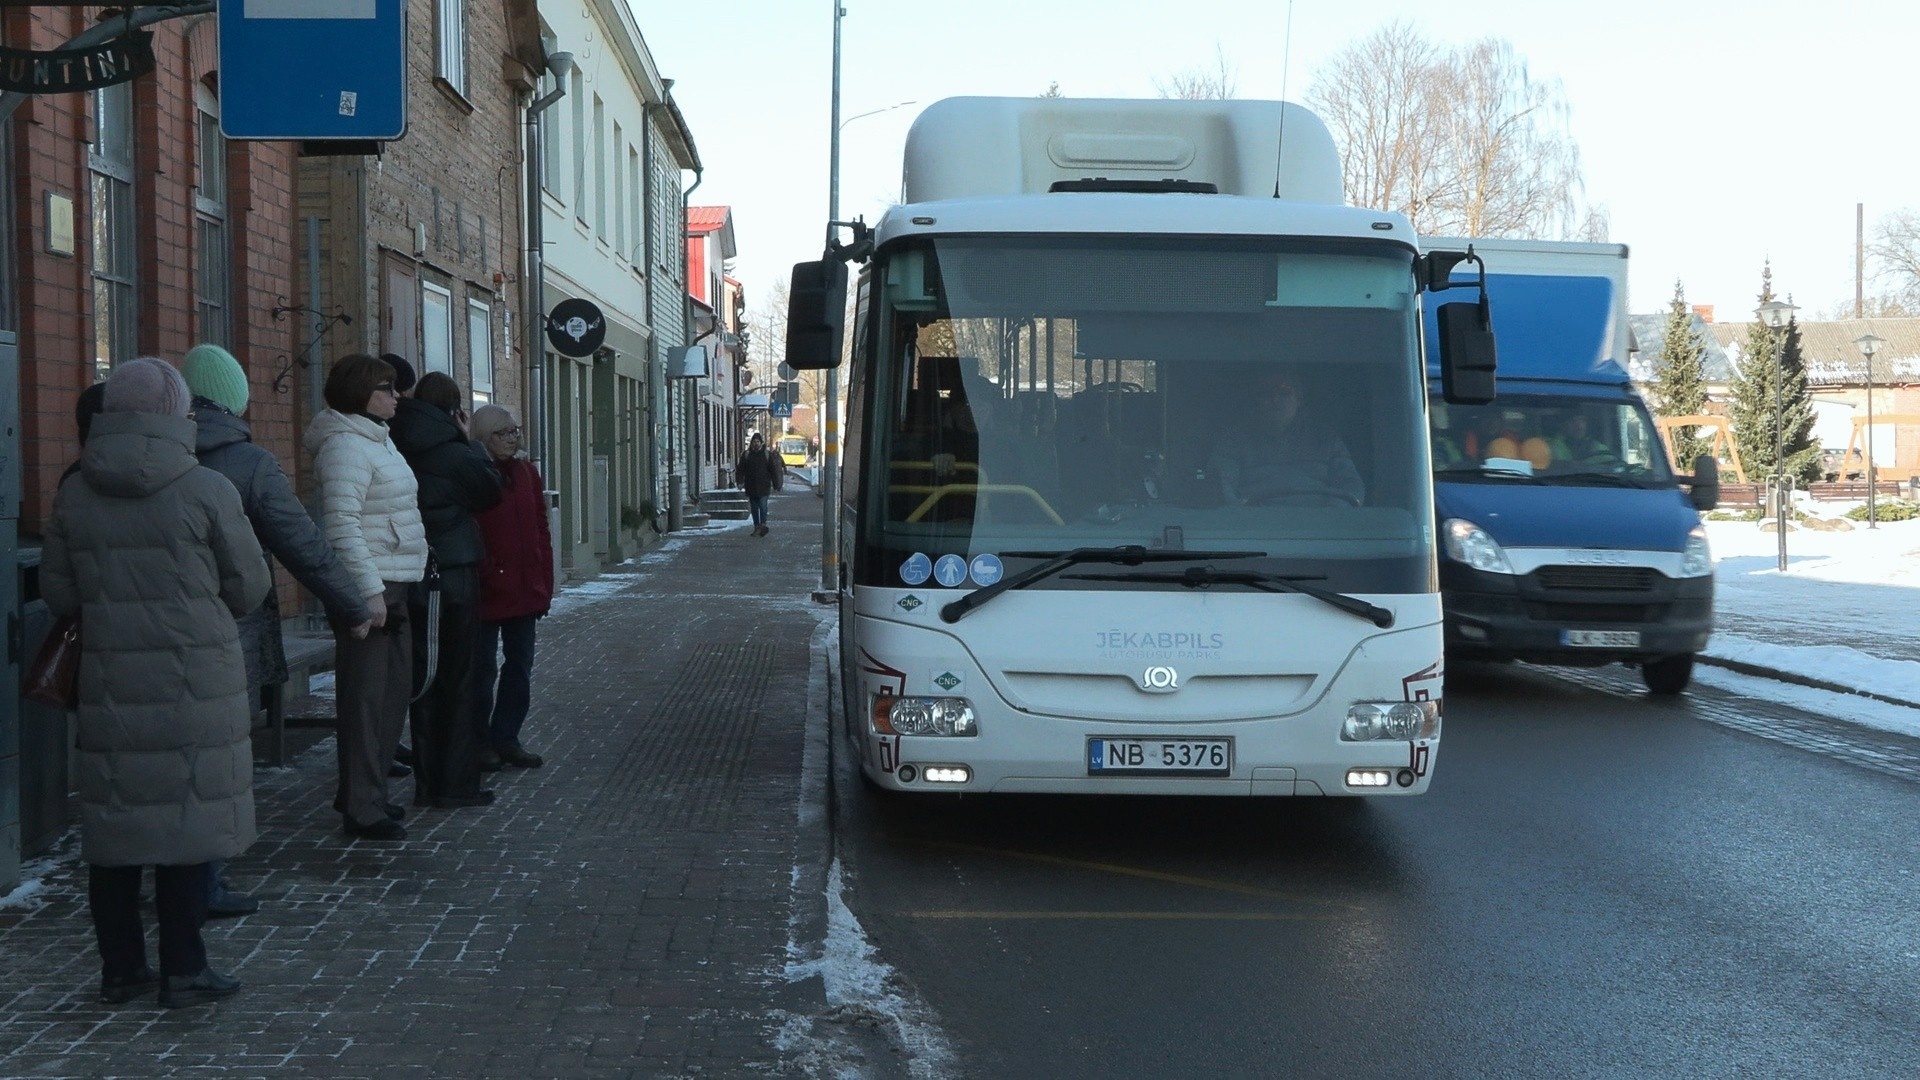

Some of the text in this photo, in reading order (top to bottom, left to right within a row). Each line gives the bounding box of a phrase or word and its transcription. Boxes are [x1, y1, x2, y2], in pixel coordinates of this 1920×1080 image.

[900, 599, 919, 607] CNG
[1096, 628, 1223, 649] JĒKABPILS
[1178, 650, 1221, 660] PARKS
[1109, 744, 1144, 766] NB
[1162, 744, 1224, 767] 5376
